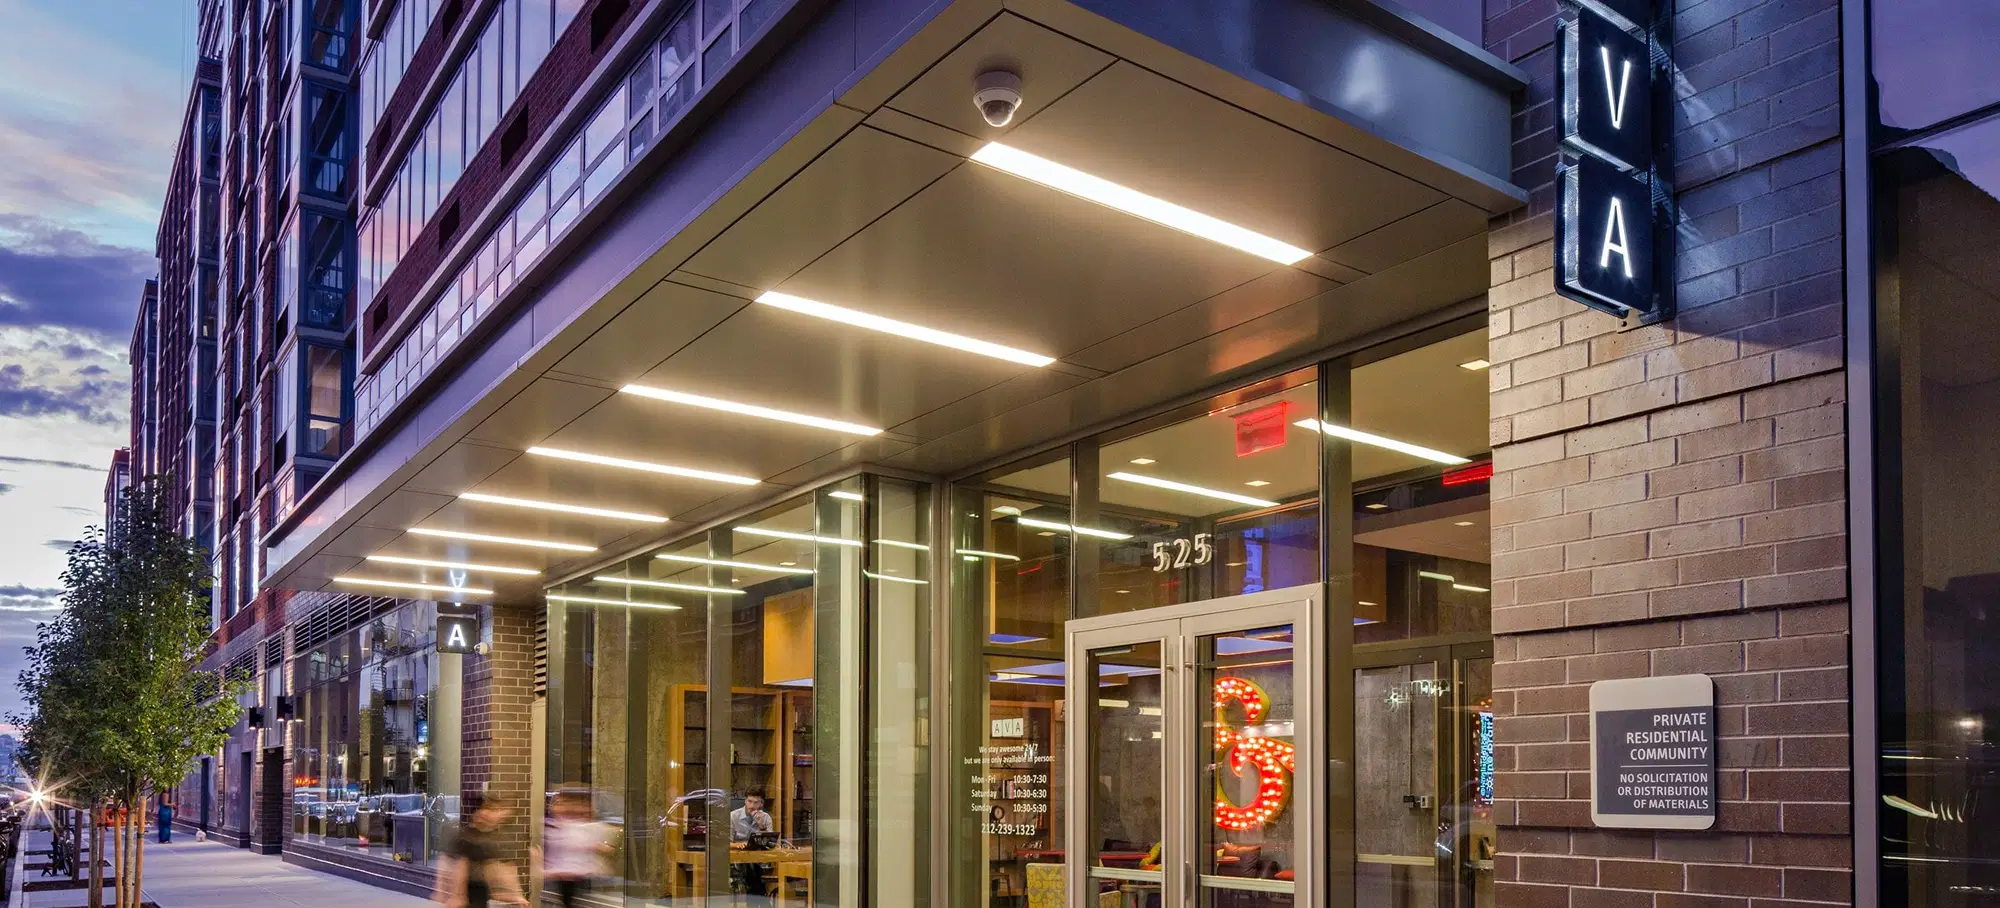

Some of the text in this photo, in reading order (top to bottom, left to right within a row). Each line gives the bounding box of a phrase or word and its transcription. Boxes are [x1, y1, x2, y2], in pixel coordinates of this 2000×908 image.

[1153, 533, 1212, 572] 525
[1653, 713, 1707, 727] PRIVATE
[994, 721, 1021, 734] AVA
[1626, 730, 1708, 744] RESIDENTIAL
[988, 745, 998, 755] stay
[1024, 743, 1038, 752] 24/7
[1630, 747, 1708, 760] COMMUNITY
[991, 756, 1002, 766] only
[1003, 755, 1026, 764] available
[1013, 775, 1047, 784] 10:30-7:30
[1620, 773, 1708, 783] NO SOLICITATION
[971, 789, 1047, 799] Saturday 10:30-6:30
[1617, 786, 1708, 796] OR DISTRIBUTION
[971, 803, 1047, 813] Sunday 10:30-5:30
[1633, 799, 1709, 809] OF MATERIALS
[981, 823, 1036, 836] 212-239-1323
